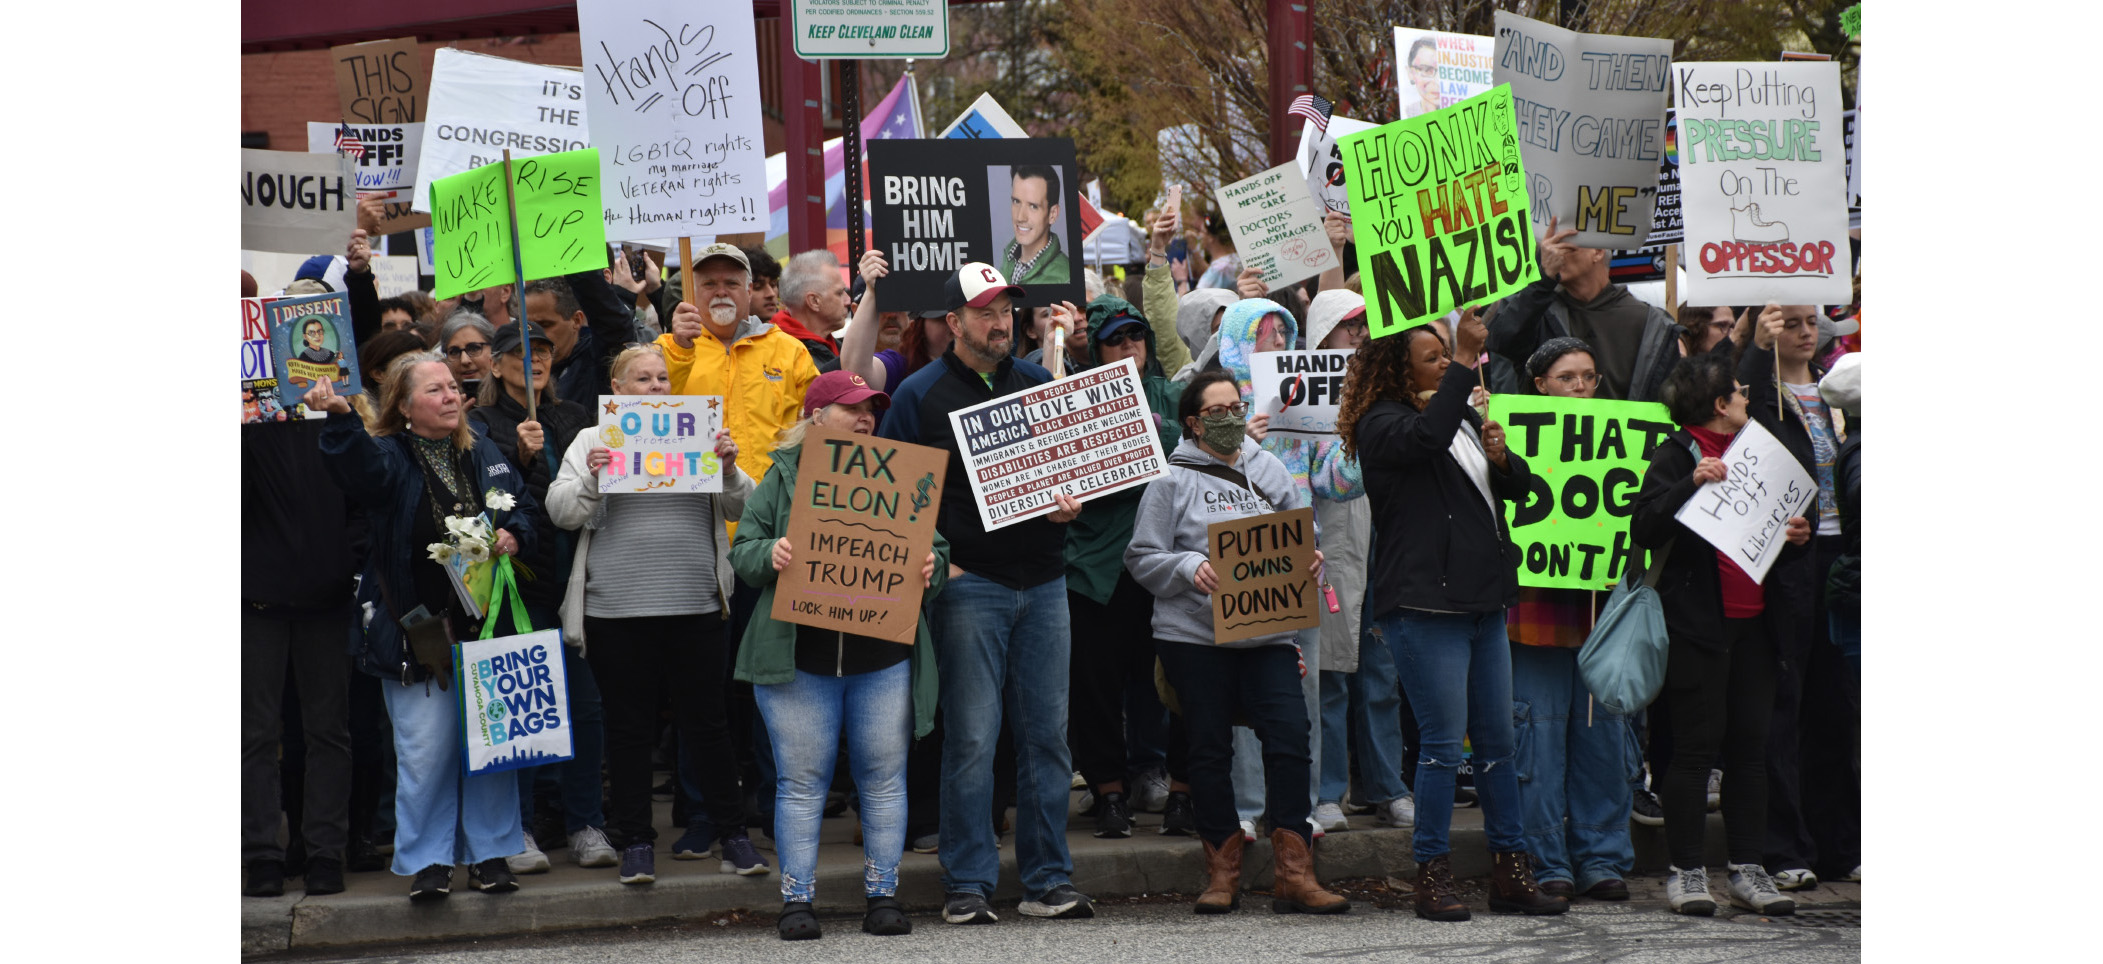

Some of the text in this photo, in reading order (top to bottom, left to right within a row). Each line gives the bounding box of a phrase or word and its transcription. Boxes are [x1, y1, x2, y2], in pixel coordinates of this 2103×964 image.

[808, 24, 934, 39] KEEP CLEVELAND CLEAN
[1436, 36, 1475, 52] WHEN
[341, 51, 412, 97] THIS
[595, 19, 715, 105] Hands
[1581, 52, 1669, 92] THEN
[542, 79, 582, 101] IT'S
[682, 75, 733, 119] Off
[1440, 81, 1468, 96] LAW
[1680, 68, 1816, 119] Keep Putting
[350, 95, 416, 125] SIGN
[536, 106, 580, 126] THE
[437, 125, 591, 154] CONGRESSIO
[613, 133, 752, 166] LGBTQ rights
[1353, 101, 1497, 203] HONK
[1572, 115, 1660, 161] CAME
[1683, 118, 1822, 164] PRESSURE
[516, 160, 594, 197] RISE
[620, 171, 741, 198] VETERAN rights
[649, 162, 719, 178] my marriage
[1224, 172, 1283, 199] HANDS OFF
[1720, 167, 1800, 196] On The
[438, 176, 497, 235] WAKE
[884, 175, 967, 207] BRING
[1238, 188, 1279, 208] MEDICAL
[1260, 193, 1286, 209] CARE
[1371, 161, 1509, 247] YOU HATE
[1378, 193, 1405, 220] IF
[902, 208, 955, 239] HIM
[1240, 210, 1292, 236] DOCTORS
[1267, 222, 1289, 235] NOT
[892, 241, 969, 272] HOME
[1370, 208, 1533, 329] NAZIS!
[1699, 240, 1836, 275] OPPESSOR
[980, 268, 997, 283] C
[273, 298, 343, 328] I DISSENT
[1025, 367, 1126, 405] ALL PEOPLE ARE EQUAL
[1028, 377, 1135, 423] LOVE WINS
[621, 412, 695, 437] OUR
[963, 403, 1025, 436] IN OUR
[1034, 397, 1135, 435] BLACK LIVES MATTER
[634, 436, 688, 444] Protect
[971, 423, 1030, 452] AMERICA
[972, 408, 1142, 467] IMMIGRANTS & REFUGEES ARE WELCOME
[980, 422, 1144, 481] DISABILITIES ARE RESPECTED
[1508, 412, 1675, 462] THAT
[606, 451, 719, 477] RIGHTS
[824, 438, 897, 485] TAX
[981, 435, 1151, 493] WOMEN ARE IN CHARGE OF THEIR BODIES
[988, 447, 1151, 504] PEOPLE & PLANET ARE VALUED OVER PROFIT
[810, 480, 900, 520] ELON
[988, 457, 1159, 520] DIVERSITY IS CELEBRATED
[1204, 489, 1266, 504] CANA
[1512, 467, 1640, 528] DOG
[1700, 447, 1759, 521] HANDS
[1206, 505, 1217, 513] IS
[1741, 479, 1801, 563] Libraries
[810, 532, 909, 566] IMPEACH
[1217, 519, 1304, 559] PUTIN
[805, 560, 904, 594] TRUMP
[1232, 555, 1294, 583] OWNS
[791, 599, 888, 625] LOCK HIM UP!
[1221, 580, 1308, 620] DONNY
[477, 645, 547, 680] BRING
[480, 664, 553, 699] YOUR
[471, 663, 492, 747] CUYAHOGA COUNTY
[489, 707, 560, 745] BAGS
